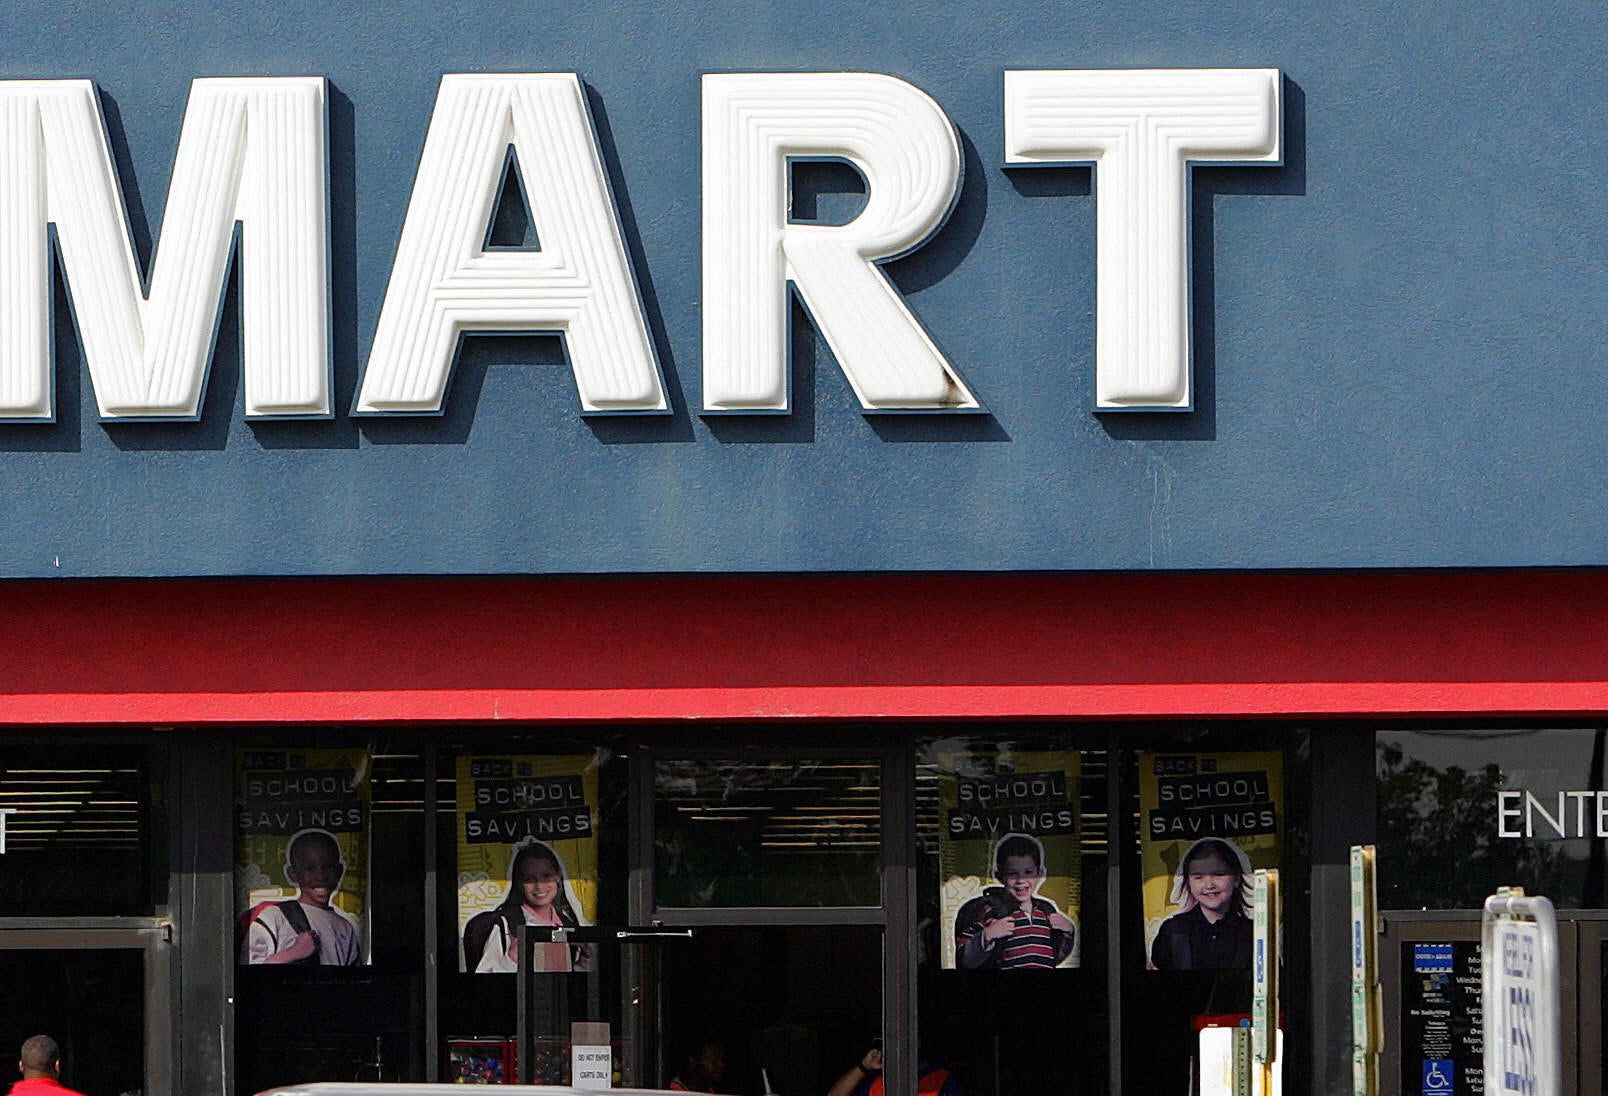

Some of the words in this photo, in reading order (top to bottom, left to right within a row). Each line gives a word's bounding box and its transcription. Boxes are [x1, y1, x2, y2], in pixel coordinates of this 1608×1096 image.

[249, 777, 355, 796] SCHOOL
[477, 783, 581, 804] SCHOOL
[959, 780, 1064, 800] SCHOOL
[1160, 779, 1266, 801] SCHOOL
[240, 808, 361, 829] SAVINGS
[467, 814, 589, 837] SAVINGS
[951, 811, 1072, 833] SAVINGS
[1151, 810, 1274, 833] SAVINGS
